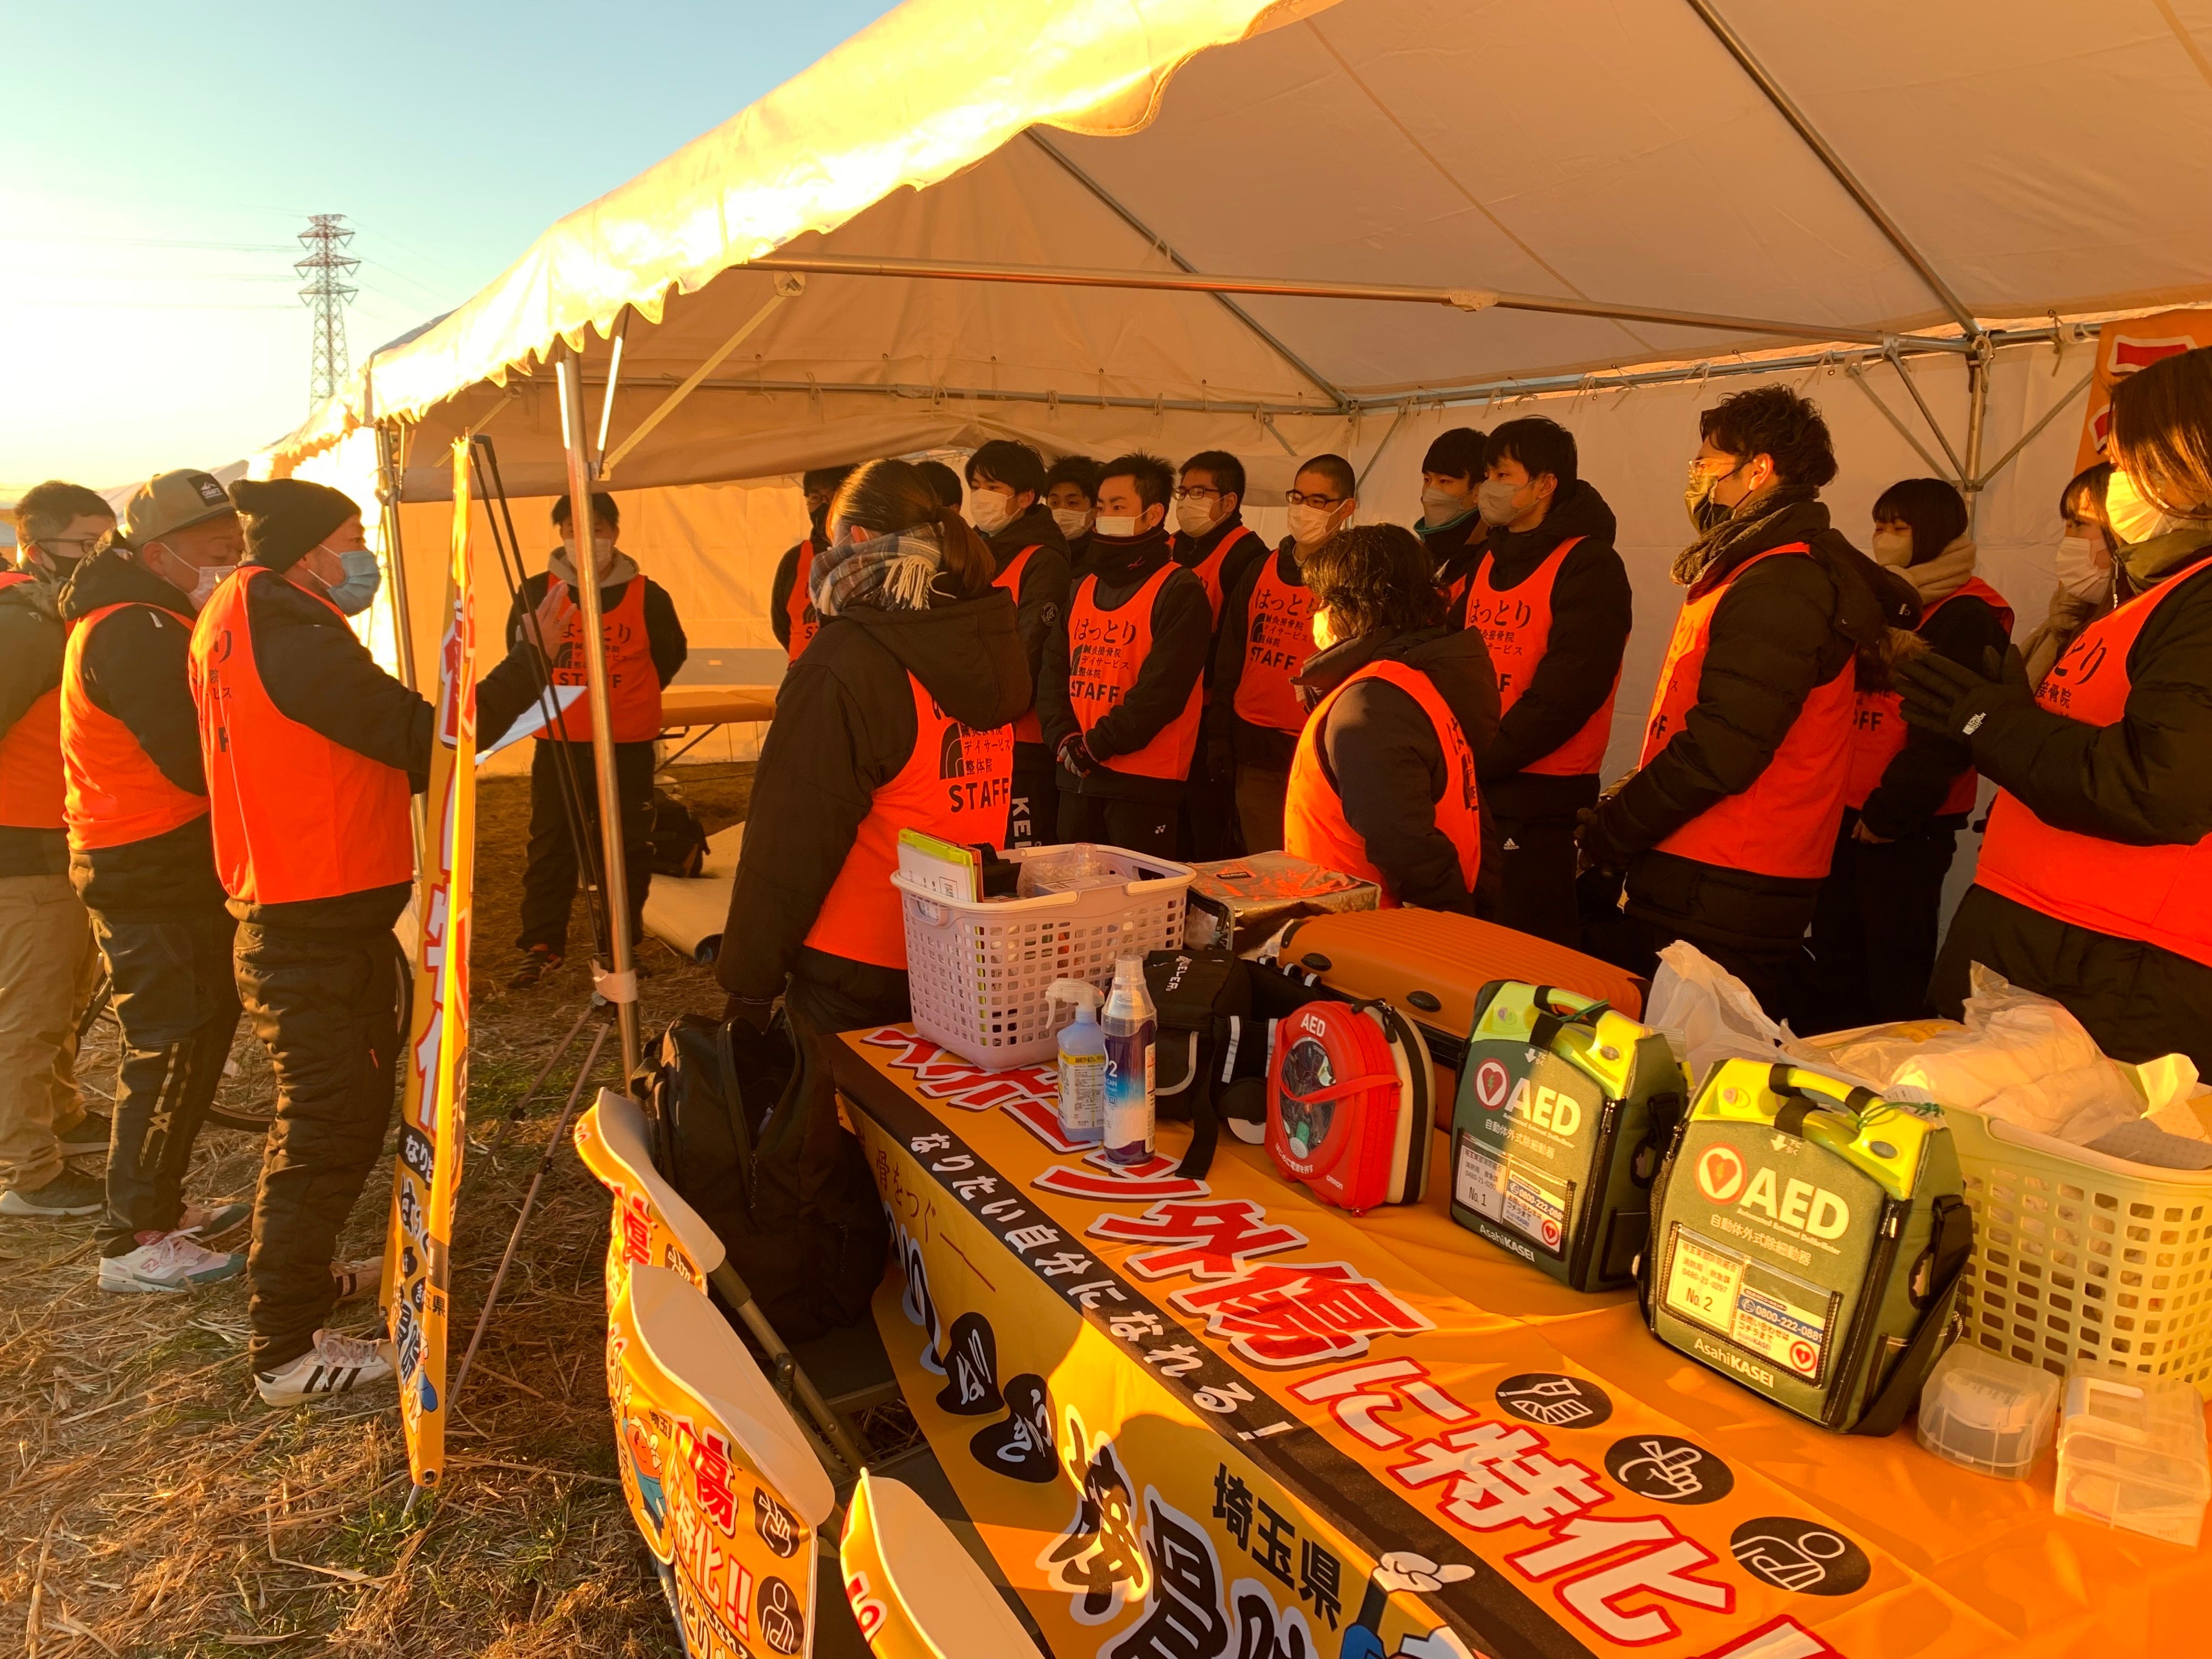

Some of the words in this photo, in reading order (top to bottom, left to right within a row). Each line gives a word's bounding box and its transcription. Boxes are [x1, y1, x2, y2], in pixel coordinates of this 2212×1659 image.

[1468, 598, 1531, 629] はっとり
[1074, 618, 1136, 645] はっとり
[1081, 656, 1129, 670] デイサービス
[1250, 646, 1297, 670] STAFF
[1078, 666, 1102, 679] 整体院
[1070, 679, 1121, 703] STAFF
[964, 737, 1011, 755] デイサービス
[965, 757, 993, 776] 整体院
[948, 777, 1009, 813] STAFF
[1301, 1012, 1326, 1039] AED
[1504, 1077, 1581, 1137] AED
[1739, 1166, 1850, 1240] AED
[1479, 1223, 1535, 1263] AsahiKASEI
[1693, 1337, 1774, 1388] AsahiKASEI
[1212, 1461, 1343, 1632] 埼玉県
